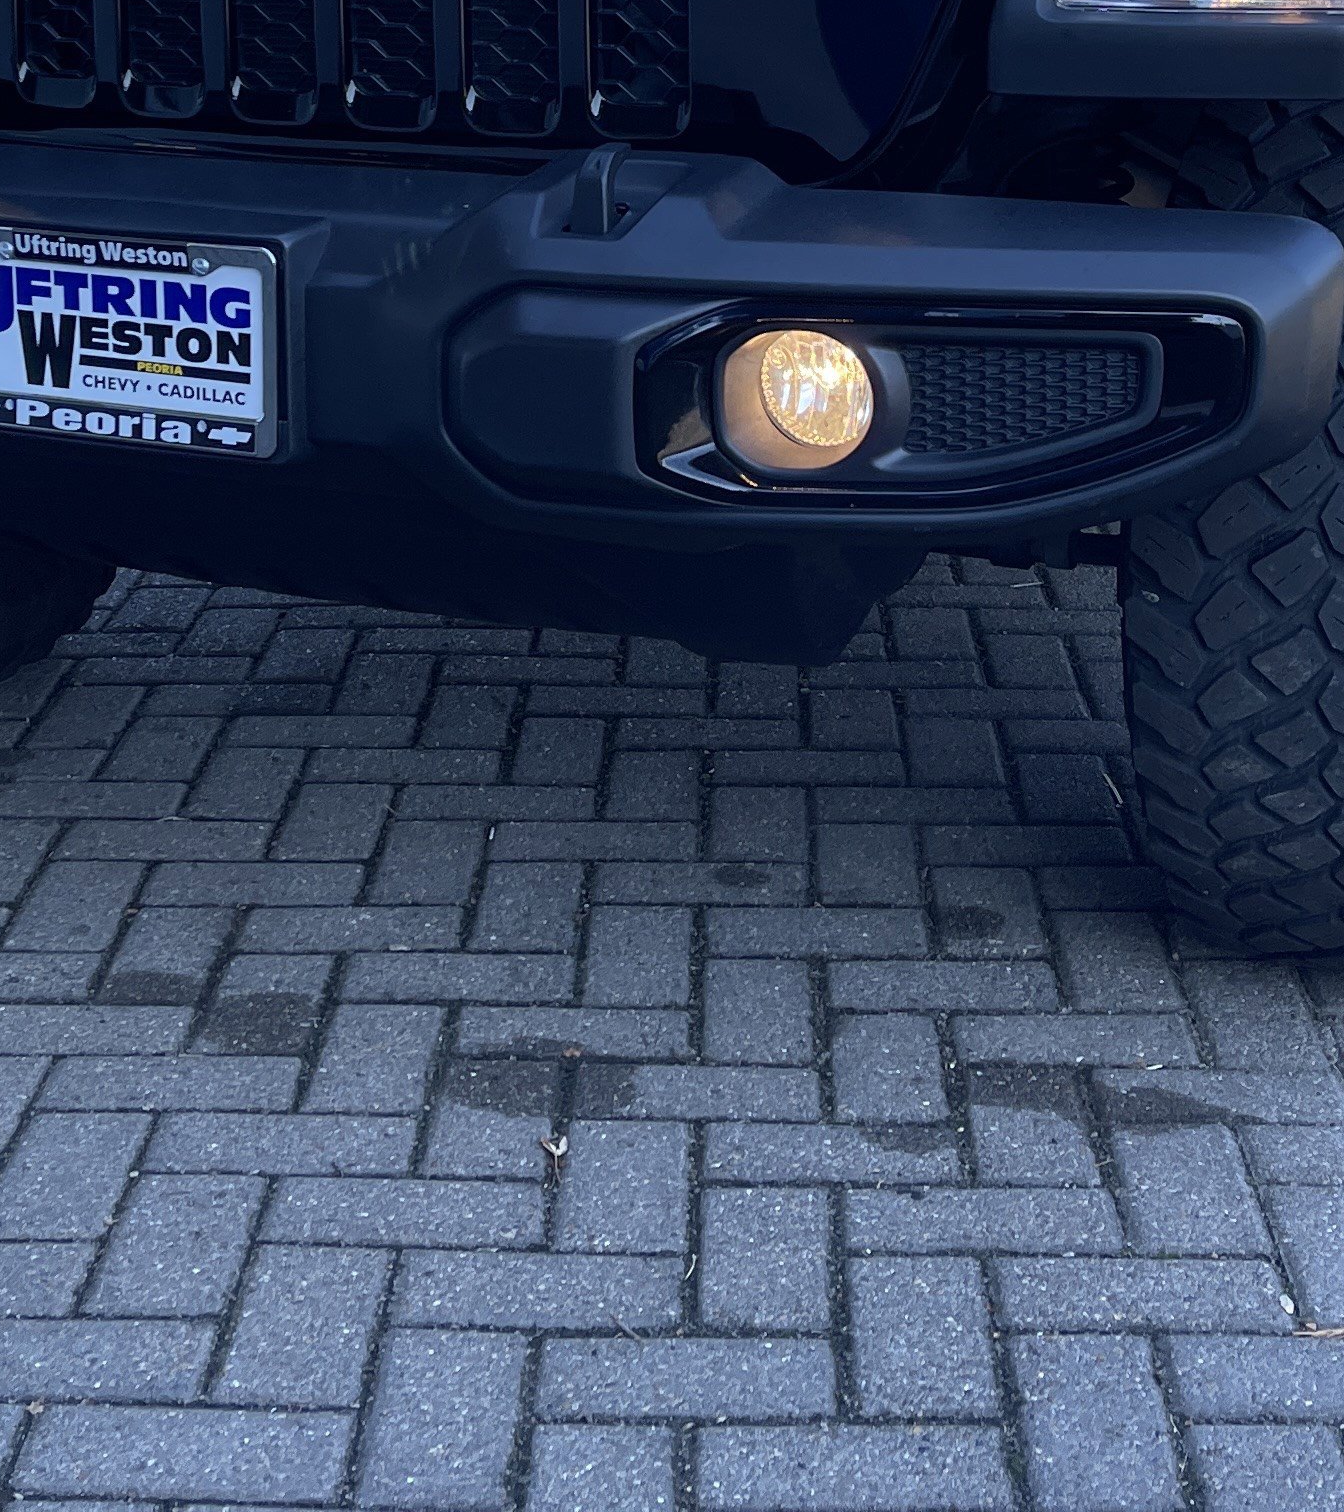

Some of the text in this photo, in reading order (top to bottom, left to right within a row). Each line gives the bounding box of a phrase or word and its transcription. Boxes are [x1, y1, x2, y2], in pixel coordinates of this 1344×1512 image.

[15, 233, 189, 268] Uftring Weston
[16, 309, 252, 389] WESTON
[136, 360, 184, 377] PEORIA
[82, 374, 247, 406] CHEVY CADILLAC
[15, 399, 192, 445] Peoria
